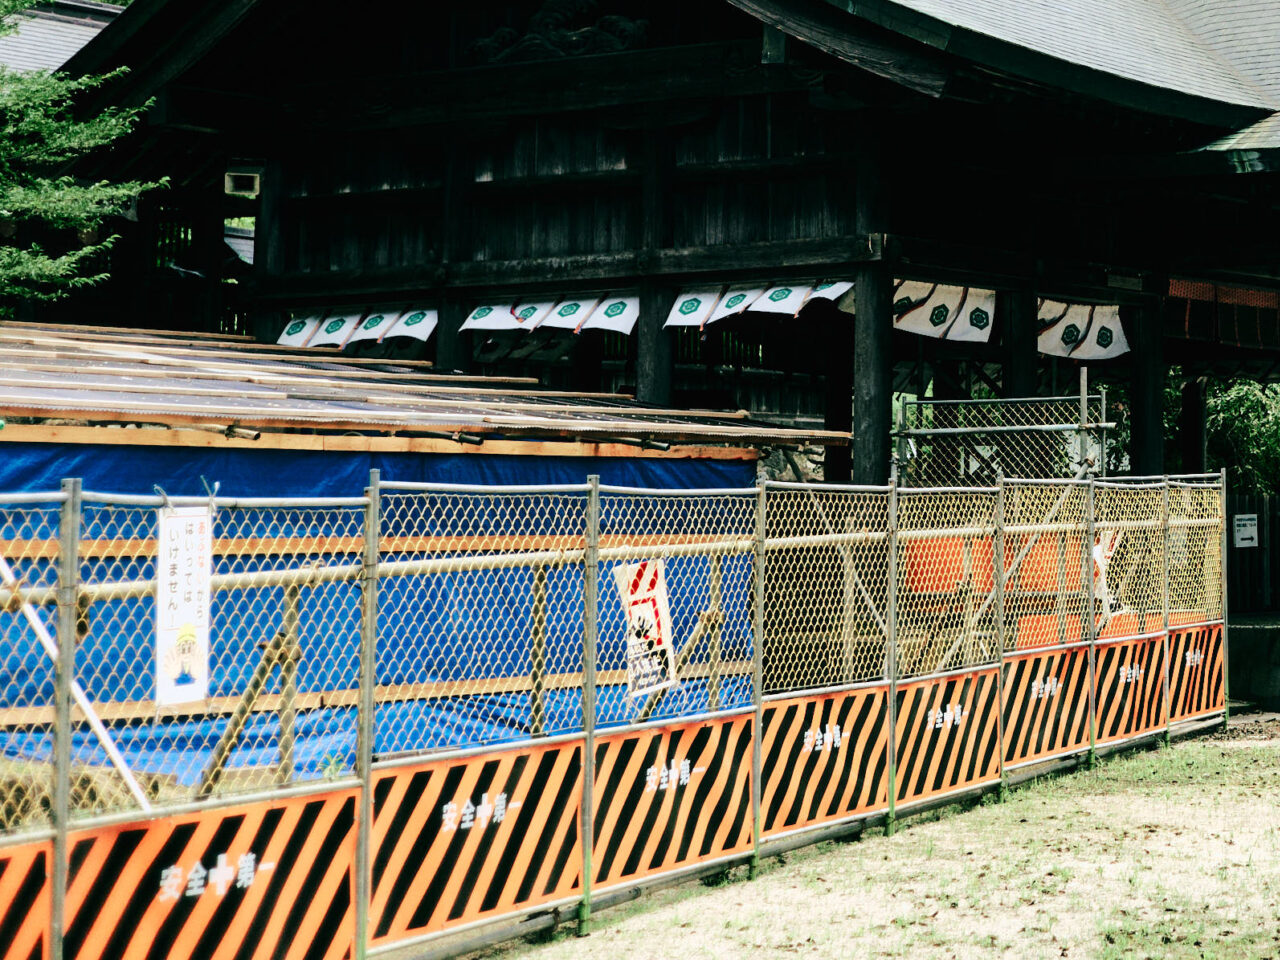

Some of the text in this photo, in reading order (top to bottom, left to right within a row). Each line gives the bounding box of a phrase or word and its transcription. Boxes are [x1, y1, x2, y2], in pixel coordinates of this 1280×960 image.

[184, 521, 194, 603] はいっては
[442, 792, 521, 832] 安全第一
[159, 851, 275, 902] 安全第一
